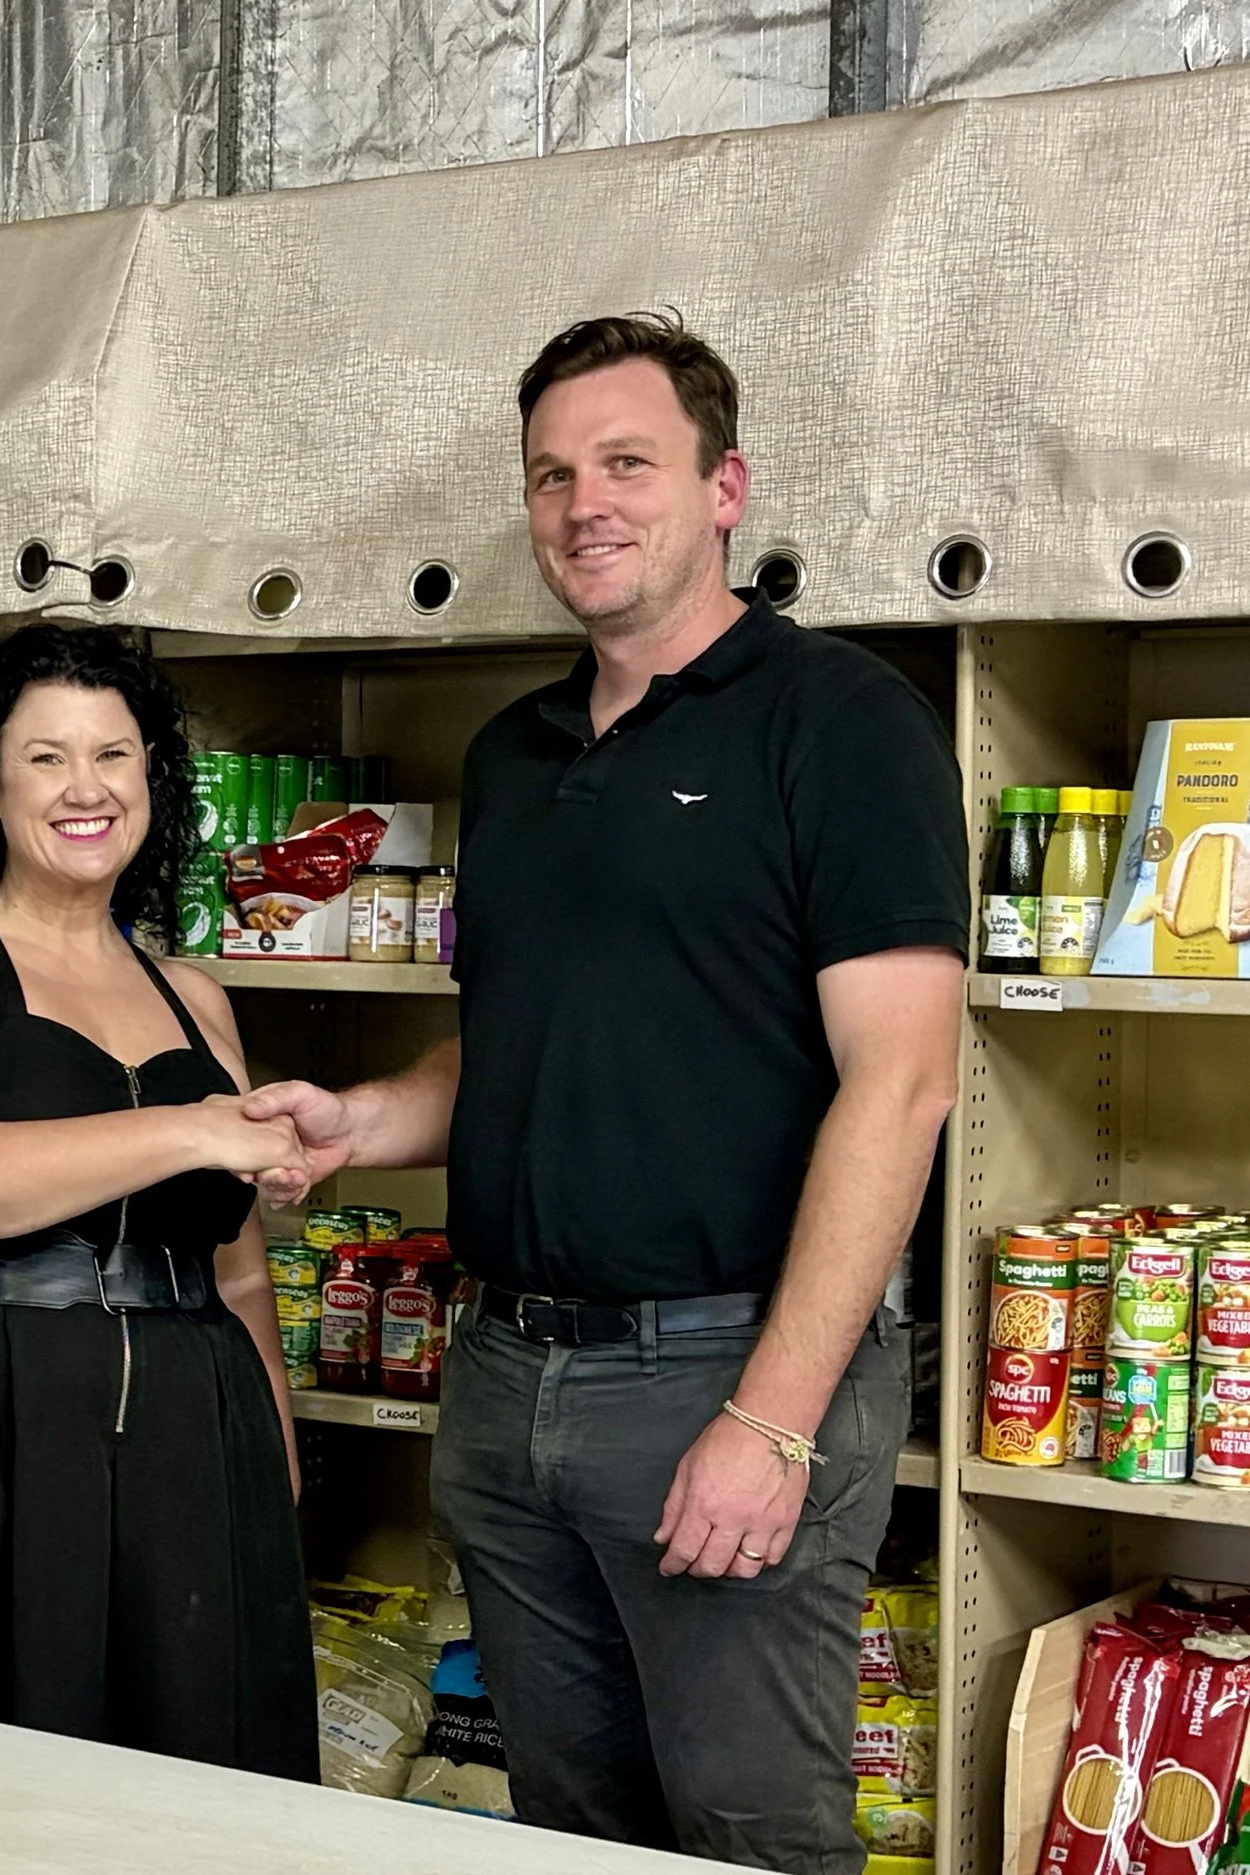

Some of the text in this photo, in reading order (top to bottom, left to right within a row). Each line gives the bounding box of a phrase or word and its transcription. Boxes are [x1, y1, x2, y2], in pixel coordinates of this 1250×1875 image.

[1176, 774, 1239, 788] PANDORO
[990, 914, 1018, 926] Lime
[988, 925, 1019, 936] Juice
[1004, 985, 1061, 1000] CHOOSE
[998, 1259, 1068, 1279] Spaghetti
[1131, 1255, 1181, 1275] Edgell
[1133, 1313, 1177, 1329] CARROTS
[1006, 1363, 1031, 1378] spc
[988, 1379, 1051, 1404] SPAGHETTI
[1188, 1665, 1214, 1737] spaghetti
